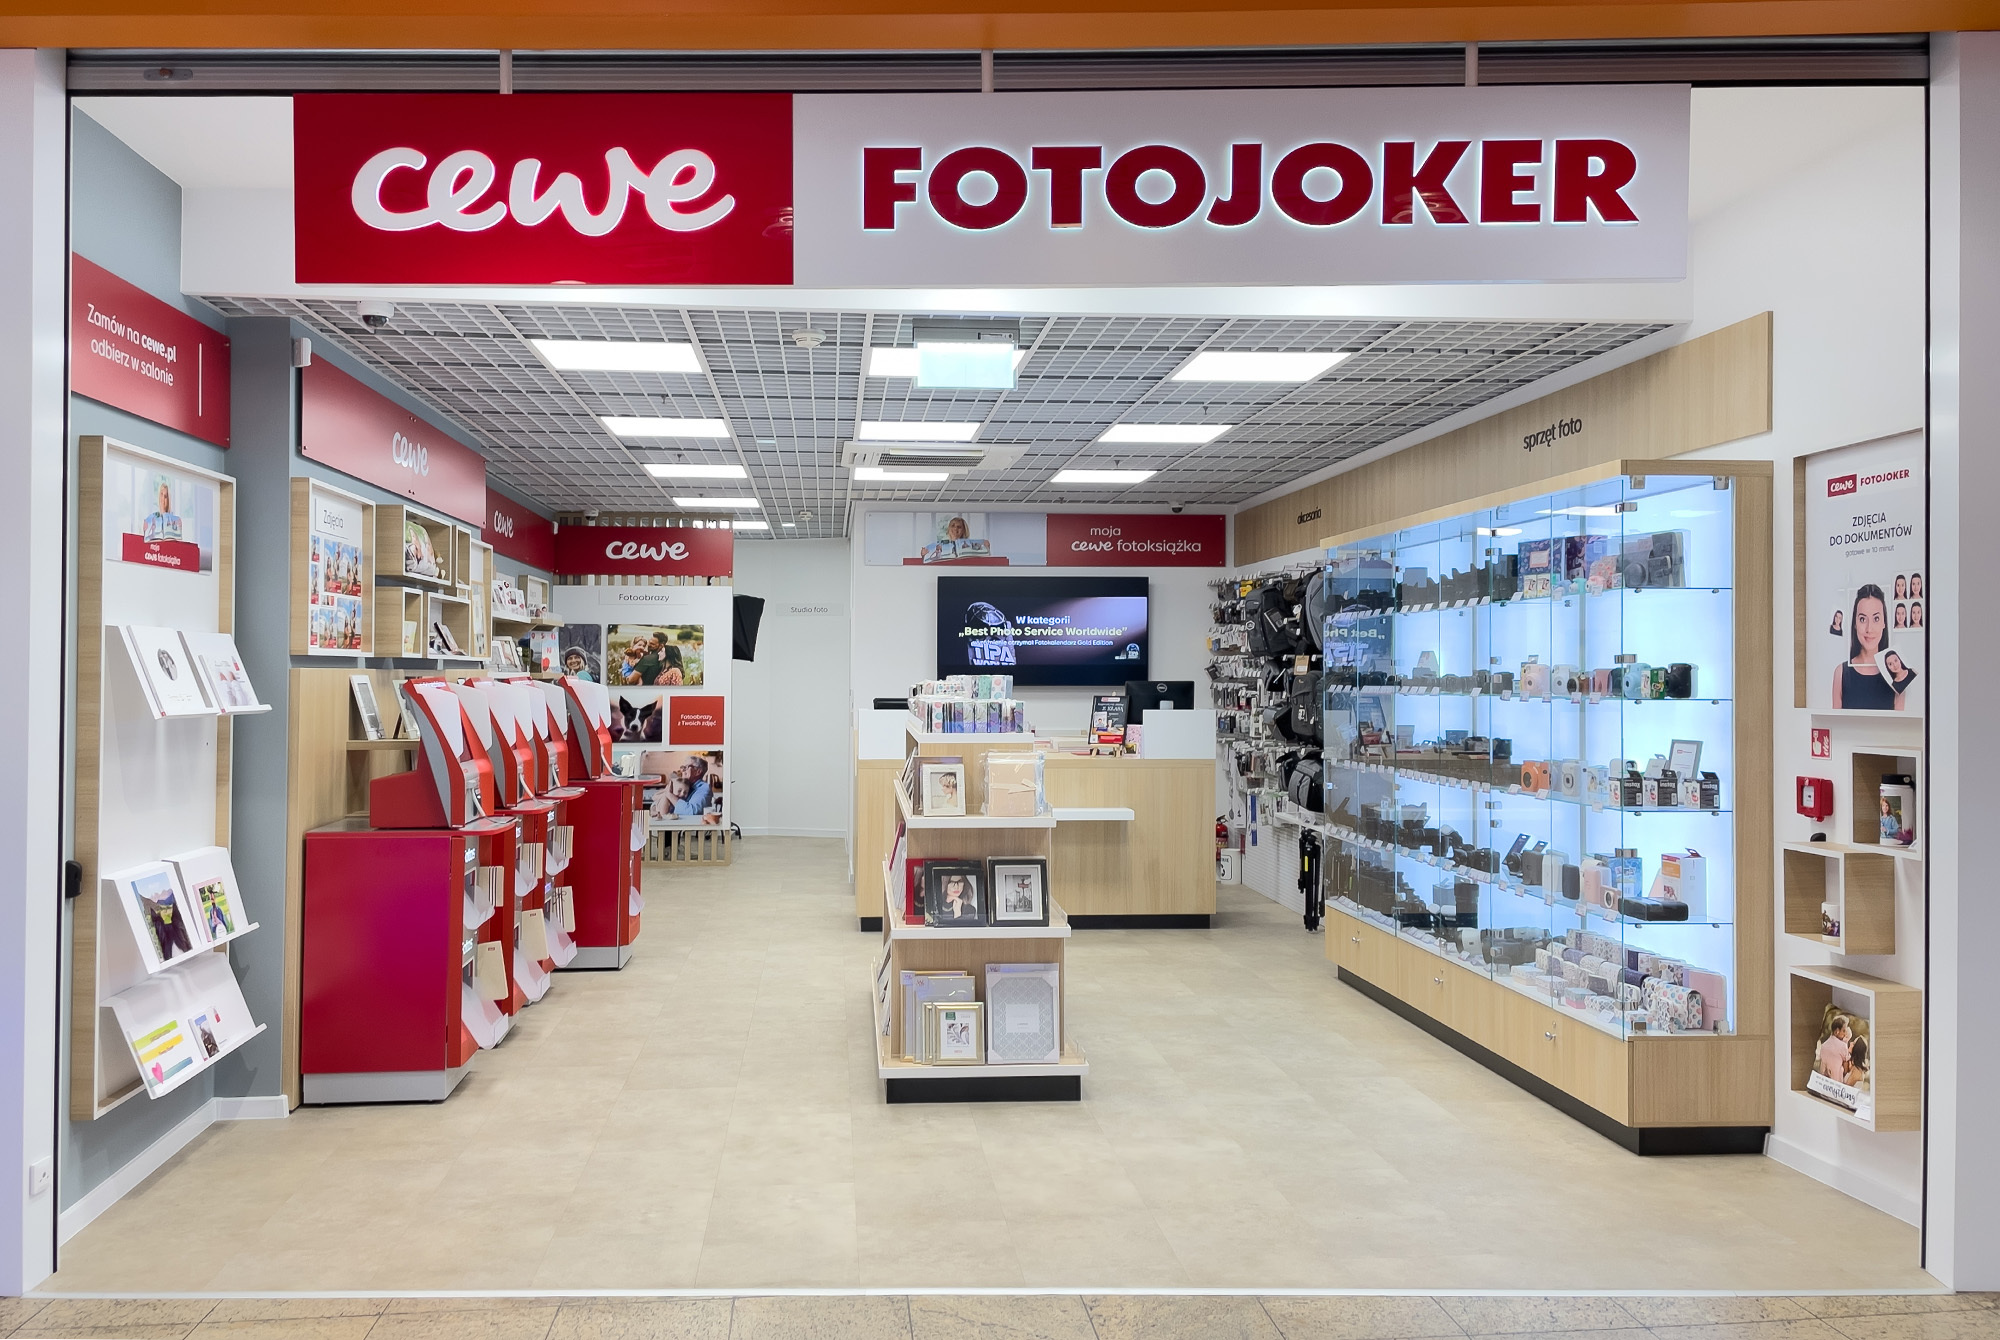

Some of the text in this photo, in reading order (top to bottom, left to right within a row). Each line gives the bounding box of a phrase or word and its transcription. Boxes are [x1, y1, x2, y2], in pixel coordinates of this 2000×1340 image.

[351, 146, 736, 237] cewe
[862, 138, 1640, 231] FOTOJOKER
[87, 303, 177, 363] Zamów na cewe.pl
[90, 338, 174, 387] odbierz w salonie
[1523, 417, 1582, 452] sprzęt foto
[392, 431, 430, 477] cewe
[1830, 469, 1910, 493] cewe FOTOJOKER
[323, 509, 344, 530] Zdjęcia
[493, 510, 514, 539] cewe
[1852, 512, 1887, 528] ZDJĘCIA
[1090, 525, 1121, 538] moja
[1829, 523, 1913, 547] DO DOKUMENTÓW
[605, 540, 690, 561] cewe
[1071, 539, 1202, 555] cewe fotoksiążka
[1845, 548, 1865, 558] gotowe
[618, 593, 670, 603] Fotoobrazy
[990, 626, 1022, 636] Photo
[1023, 626, 1063, 636] Service
[1065, 626, 1128, 636] Worldwide”
[1015, 615, 1071, 626] W kategorii
[971, 643, 1015, 663] TIPA
[680, 713, 713, 721] Fotoobrazy
